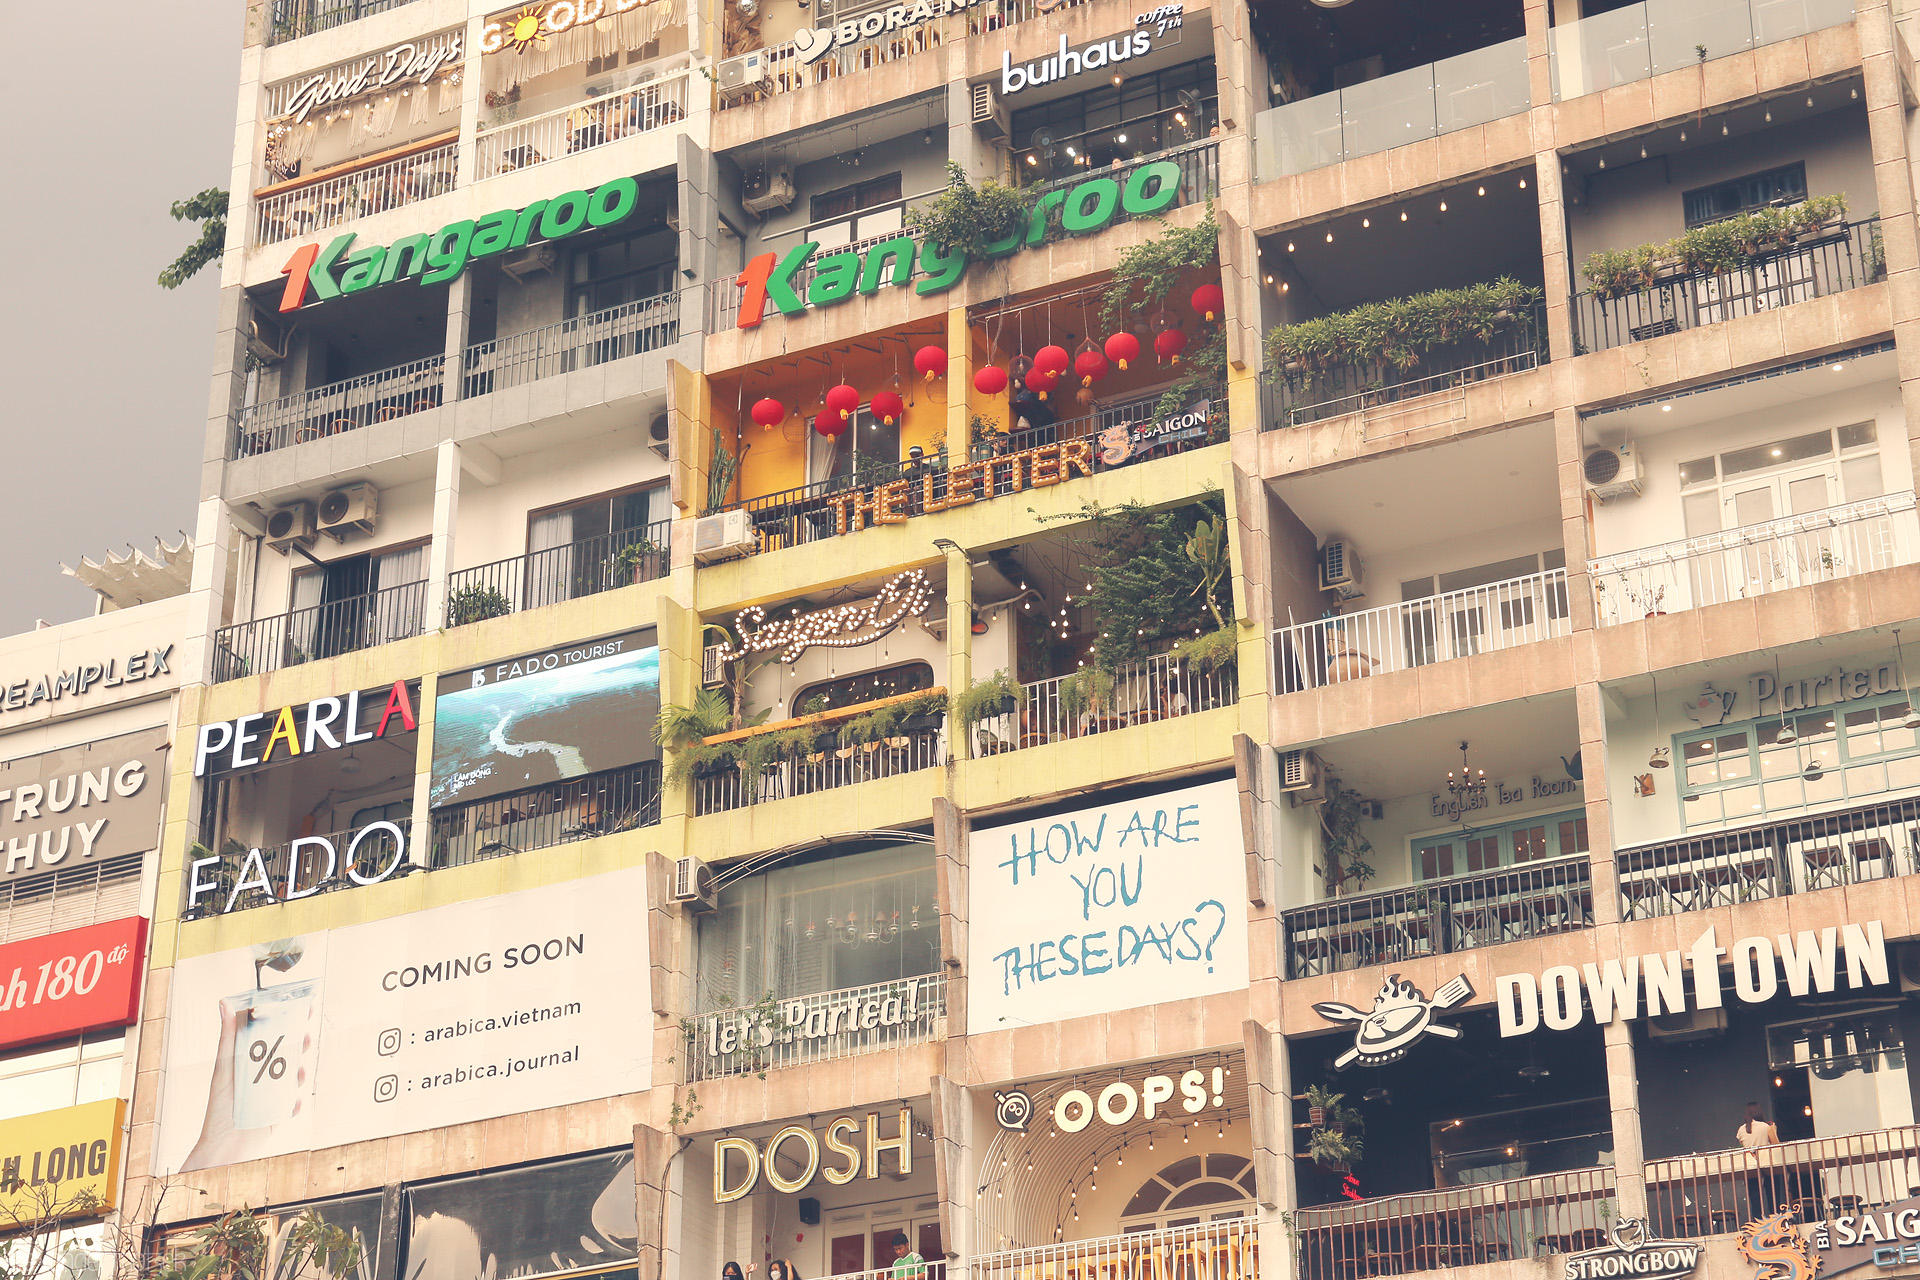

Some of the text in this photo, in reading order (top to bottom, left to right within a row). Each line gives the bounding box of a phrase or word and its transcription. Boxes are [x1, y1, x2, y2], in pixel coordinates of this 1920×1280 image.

[1134, 3, 1184, 25] coffee
[285, 38, 462, 124] Good Days
[1158, 427, 1208, 444] CHILL
[827, 438, 1093, 535] THE LETTER
[496, 640, 625, 682] FADO TOURIST
[1749, 662, 1901, 718] Partea
[195, 680, 416, 777] PEARLA
[1494, 782, 1523, 804] Tea
[1531, 775, 1576, 799] Room
[0, 818, 108, 873] HUY
[187, 820, 405, 921] FADO
[998, 804, 1200, 886] HOW ARE
[1070, 855, 1143, 920] YOU
[33, 950, 104, 1005] 180
[107, 943, 129, 964] độ
[381, 933, 585, 992] COMING SOON
[424, 1001, 582, 1043] arabica.vietnam
[421, 1045, 580, 1090] arabica.journal
[1054, 1066, 1225, 1133] OOPS!
[31, 1139, 107, 1187] LONG
[713, 1106, 913, 1205] DOSH
[1815, 1218, 1831, 1250] BIA
[1565, 1247, 1698, 1280] STRONGBOW
